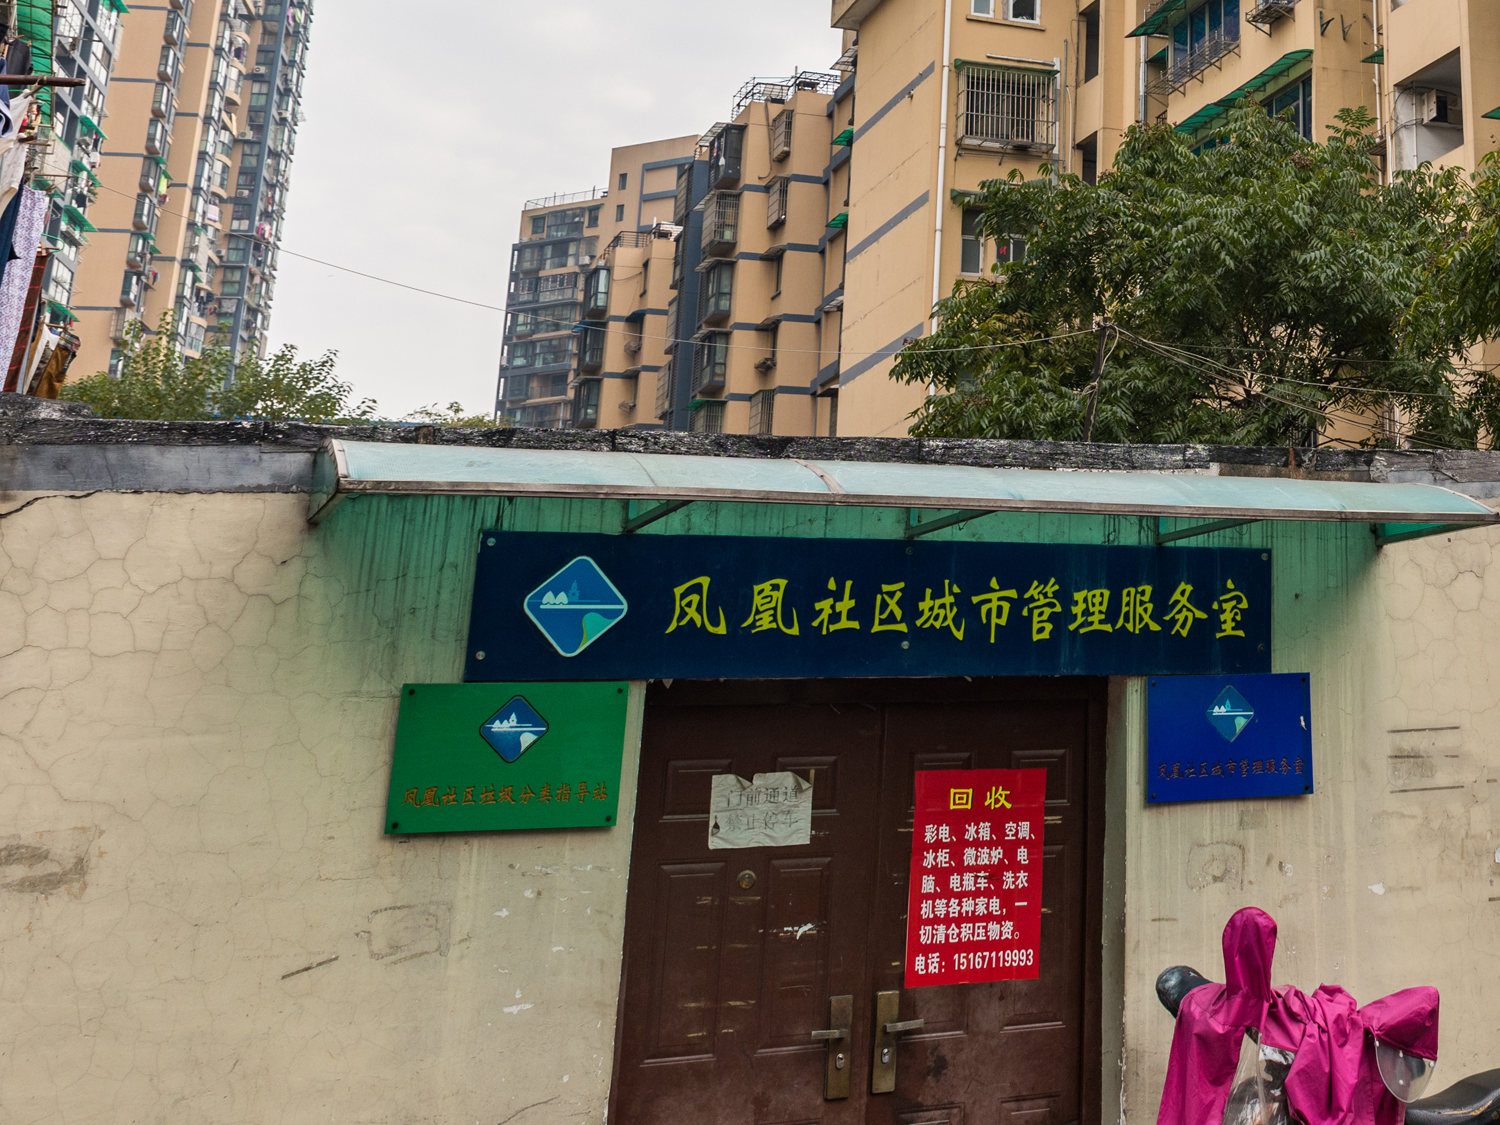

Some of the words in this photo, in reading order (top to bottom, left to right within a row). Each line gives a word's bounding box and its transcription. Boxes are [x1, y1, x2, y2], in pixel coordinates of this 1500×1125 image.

[664, 575, 1249, 644] 凤凰社区城市管理服务室
[1157, 755, 1304, 780] 凤凰社区城市管理服务室
[402, 781, 608, 808] 凤凰社区垃圾分类指导站
[726, 785, 800, 807] 门前通道
[949, 786, 1013, 810] 回收
[725, 810, 799, 832] 禁止停车
[924, 821, 1036, 844] 彩电、冰箱、空调、
[922, 846, 1029, 868] 冰柜、微波炉、电
[921, 871, 1029, 894] 脑、电瓶车、洗衣
[920, 896, 1028, 919] 机等各种家电，一
[919, 920, 1020, 945] 切清仓积压物资。
